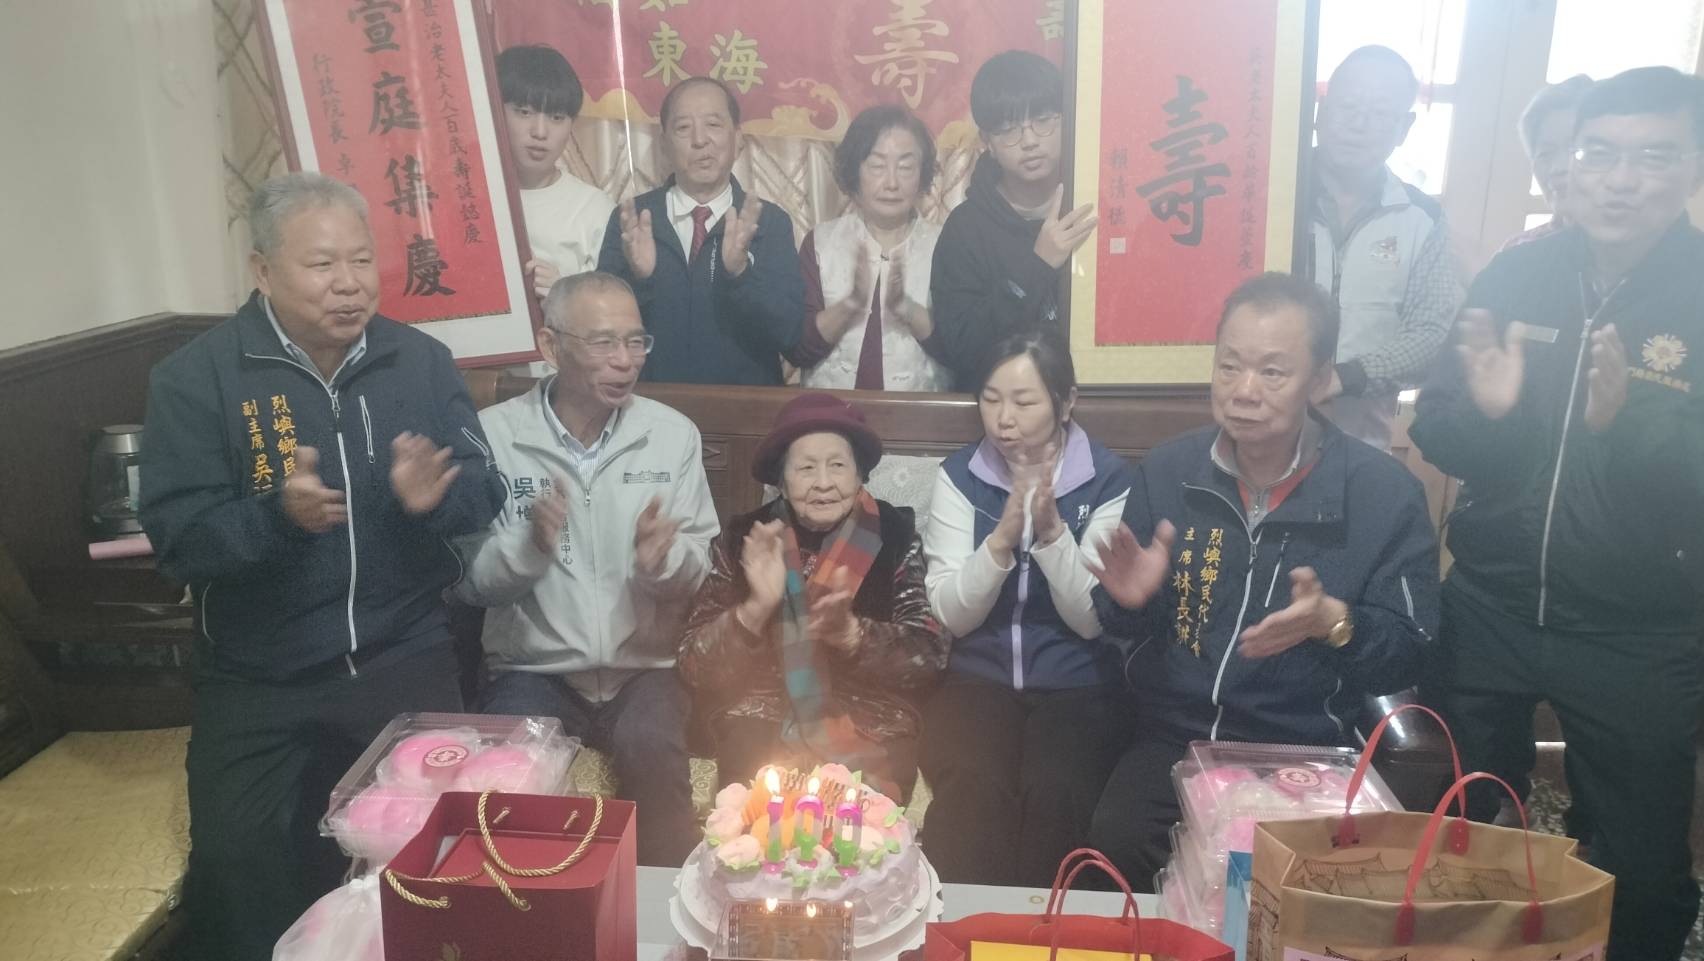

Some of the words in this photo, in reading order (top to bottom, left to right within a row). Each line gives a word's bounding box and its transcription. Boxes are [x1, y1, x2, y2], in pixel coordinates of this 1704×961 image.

[642, 20, 769, 95] 東海
[312, 52, 360, 190] 行政院長卓
[1135, 75, 1232, 246] 壽
[242, 399, 273, 496] 副主席吳
